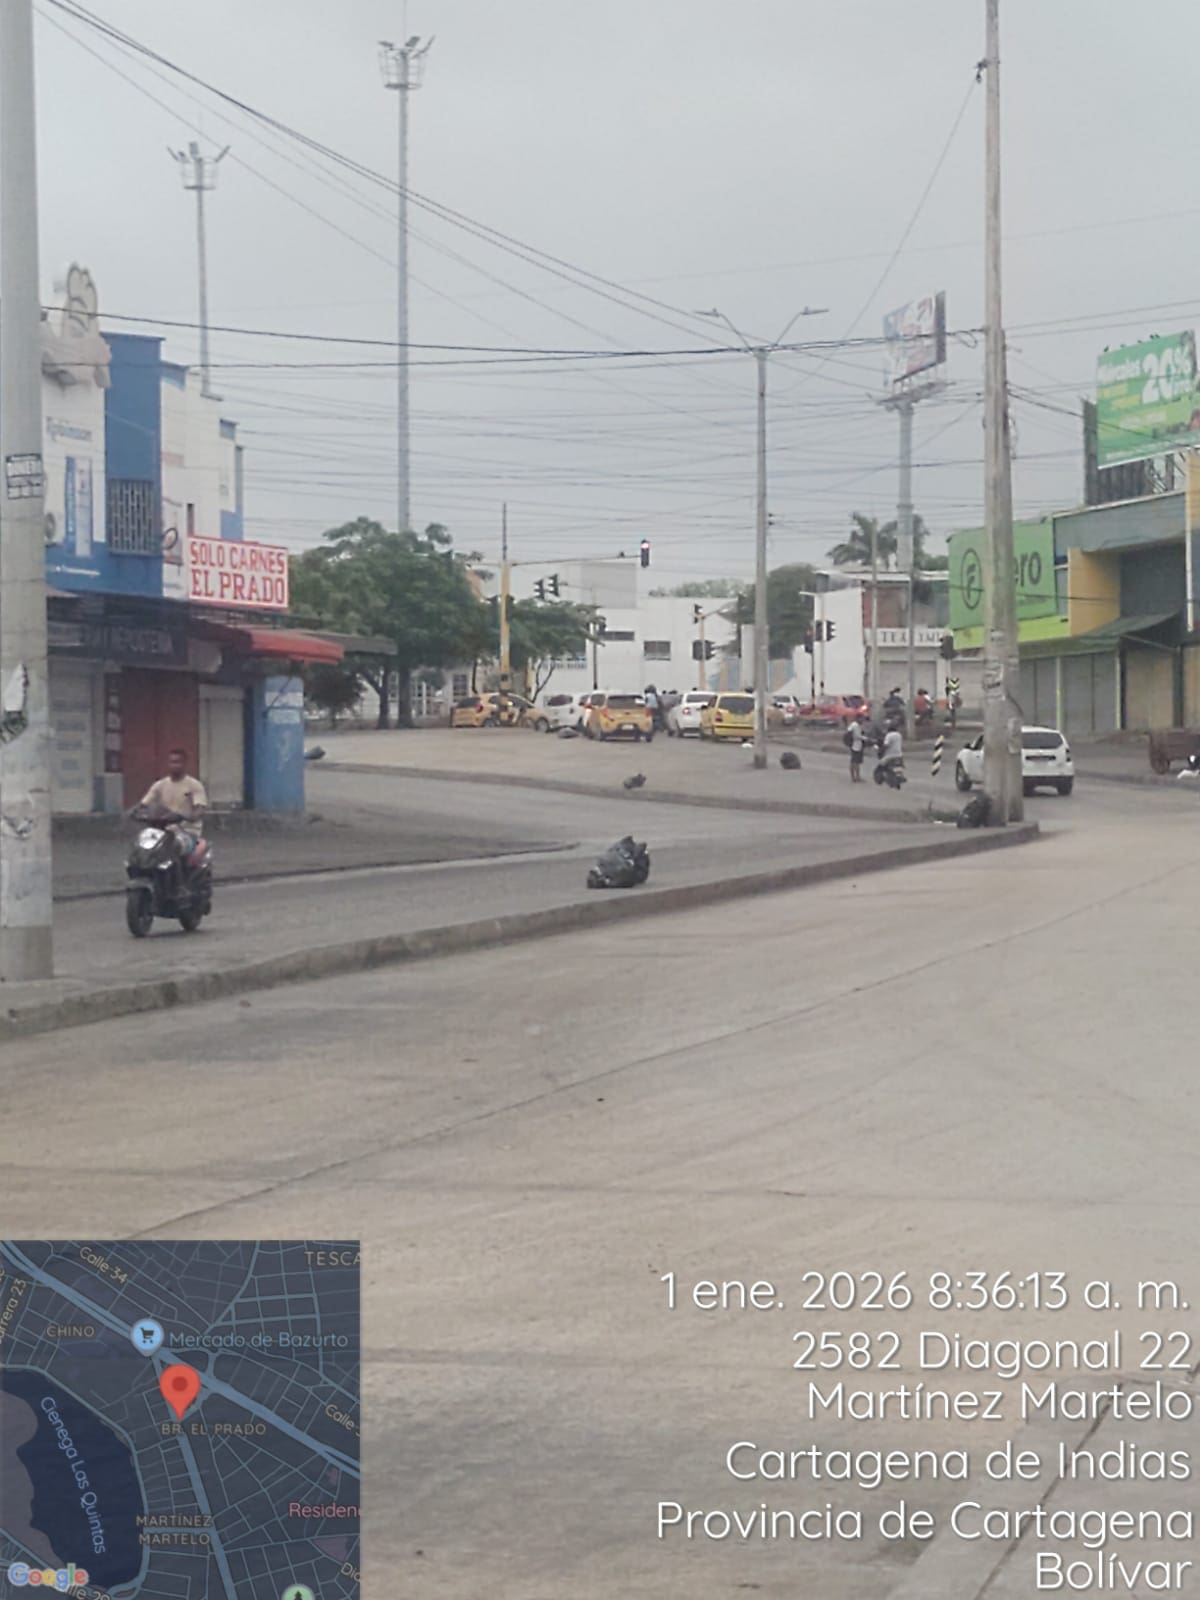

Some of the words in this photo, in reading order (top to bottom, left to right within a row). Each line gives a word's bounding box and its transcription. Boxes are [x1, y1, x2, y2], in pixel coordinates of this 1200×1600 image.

[190, 541, 225, 567] SOLO
[230, 546, 285, 574] CARNES
[191, 569, 213, 596] EL
[218, 571, 285, 604] PRADO
